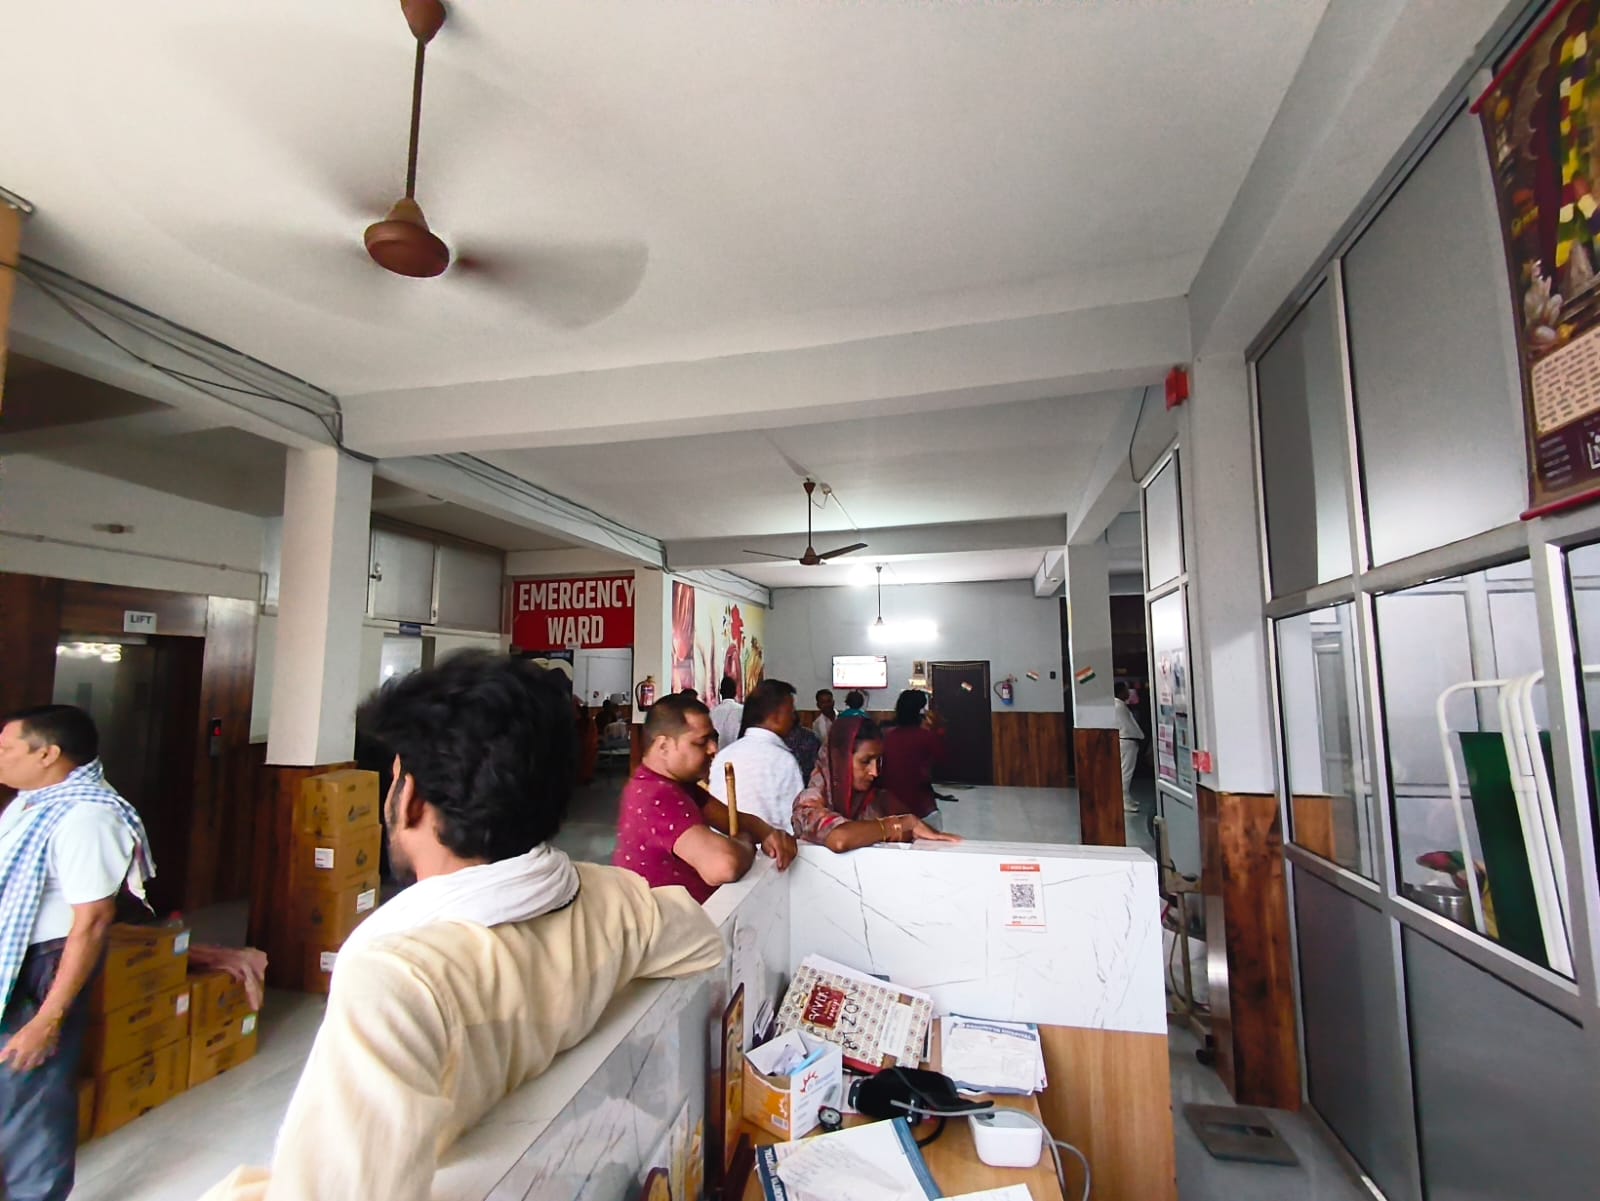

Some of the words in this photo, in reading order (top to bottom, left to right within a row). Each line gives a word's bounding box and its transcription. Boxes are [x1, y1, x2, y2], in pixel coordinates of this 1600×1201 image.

[518, 579, 635, 611] EMERGENCY
[130, 614, 152, 624] LIFT
[547, 615, 604, 645] WARD
